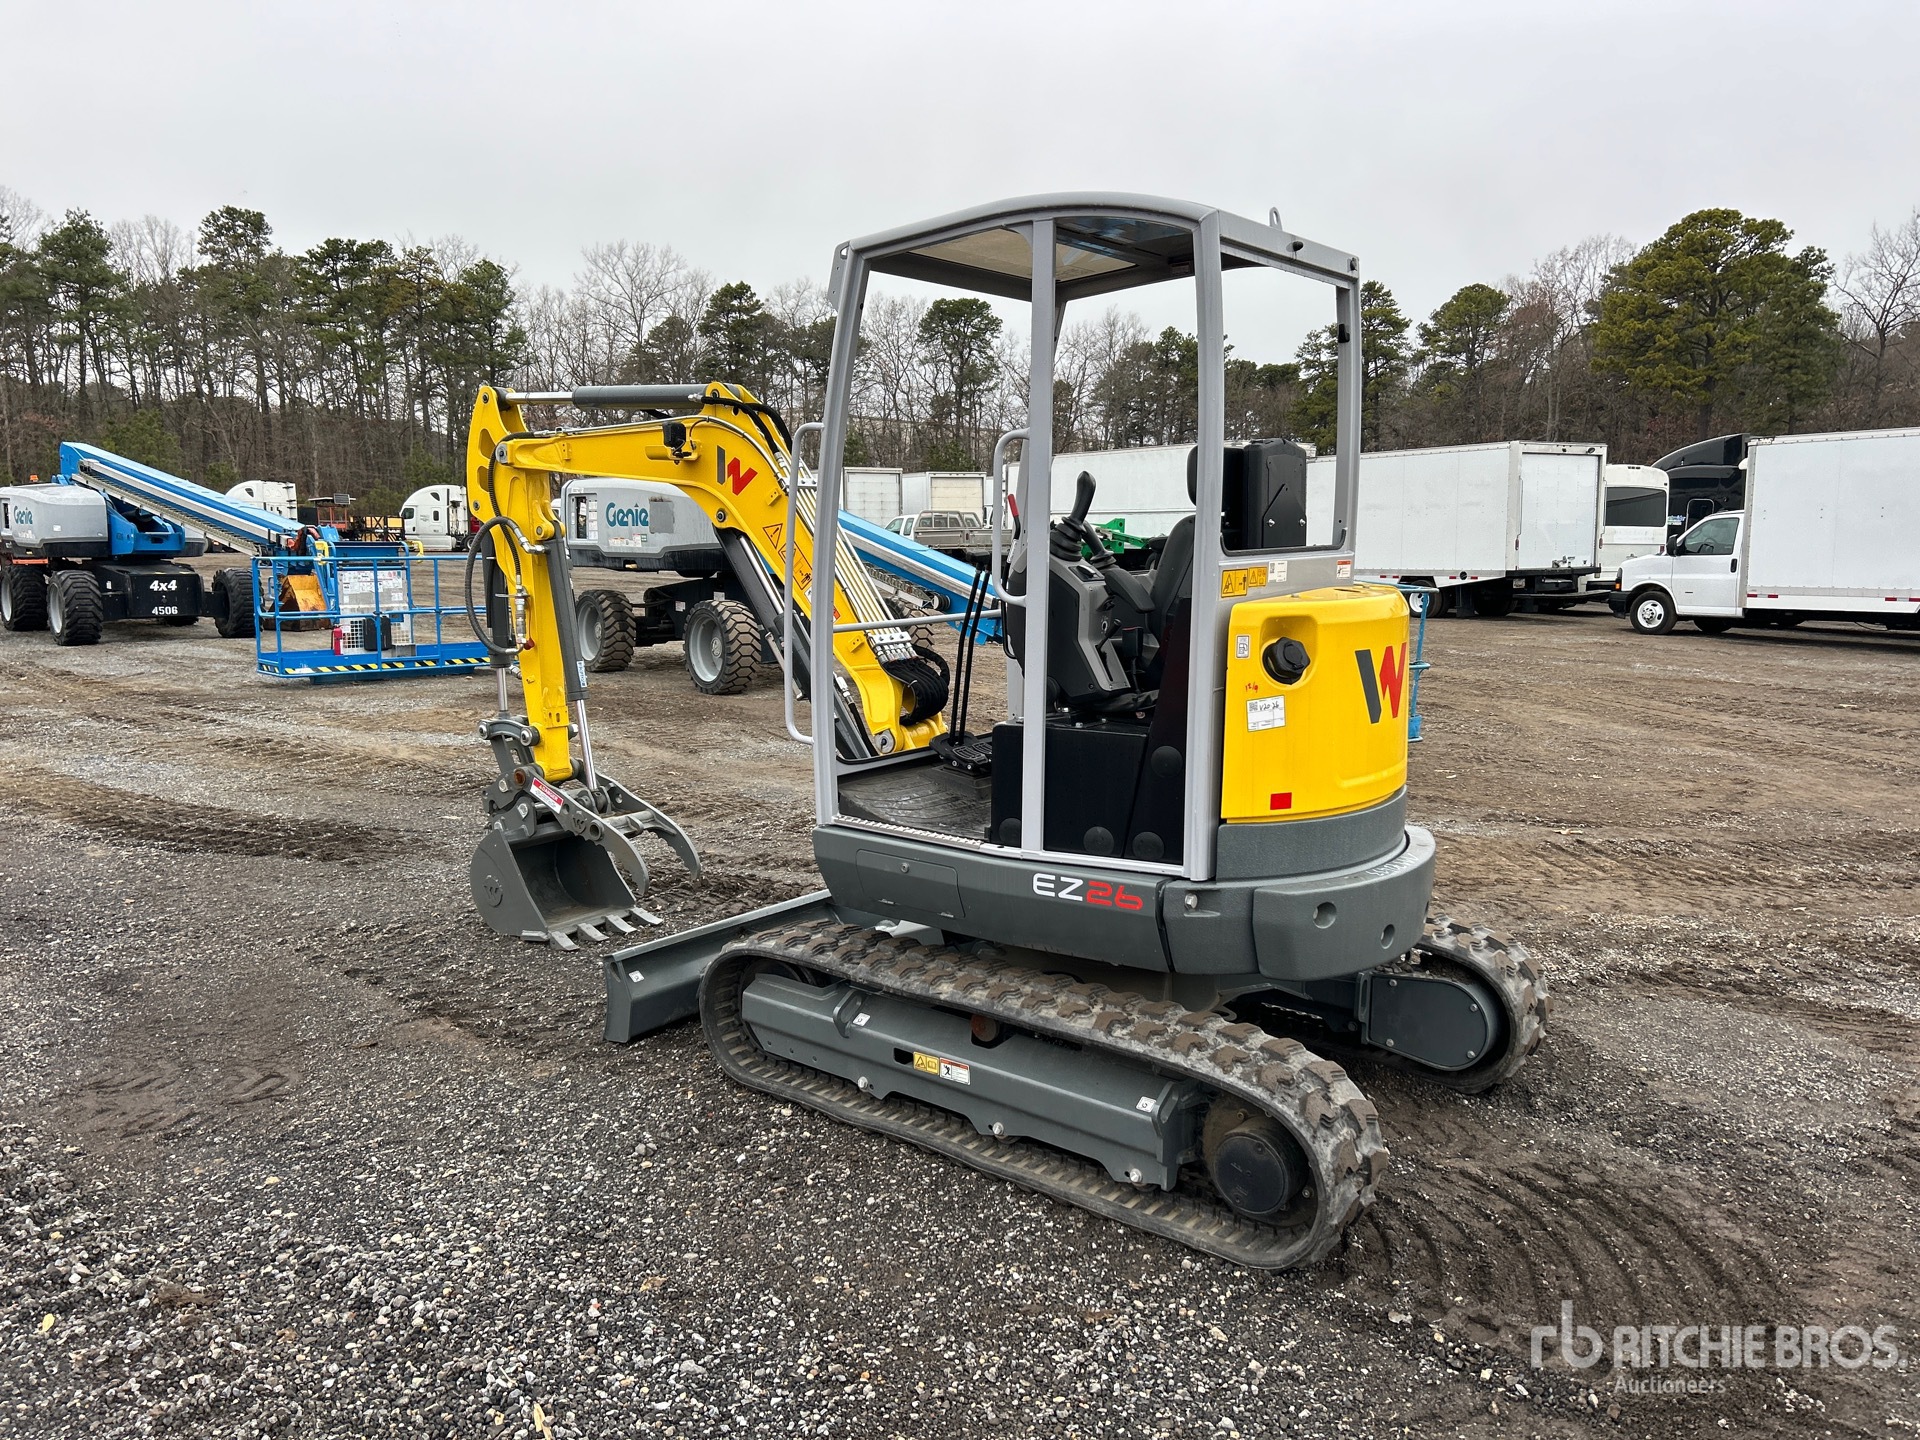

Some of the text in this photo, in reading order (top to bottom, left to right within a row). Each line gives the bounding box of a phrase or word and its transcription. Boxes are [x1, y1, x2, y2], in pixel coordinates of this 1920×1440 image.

[13, 505, 33, 525] Genie
[606, 502, 649, 527] Genie
[150, 579, 178, 591] 4x4
[152, 606, 178, 615] 4506
[1032, 872, 1143, 911] EZ26
